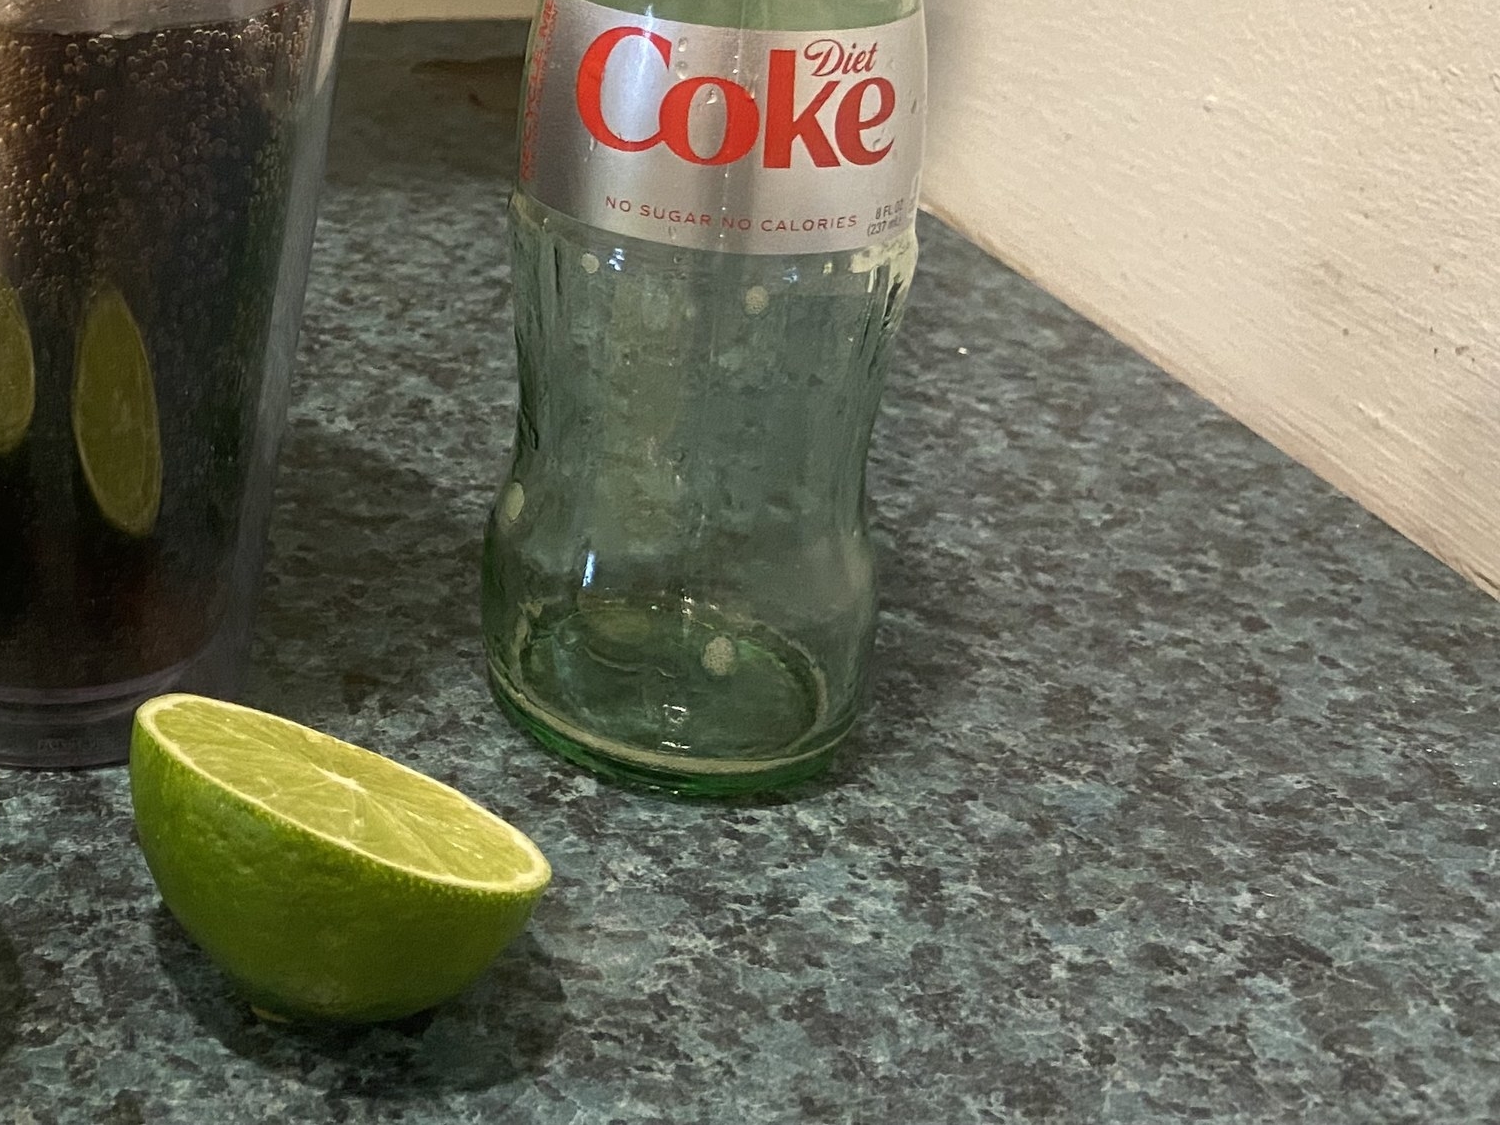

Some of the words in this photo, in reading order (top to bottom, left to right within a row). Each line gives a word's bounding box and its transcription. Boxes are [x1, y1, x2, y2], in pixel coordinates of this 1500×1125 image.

[804, 38, 878, 77] Diet
[575, 26, 896, 169] Coke
[605, 196, 632, 213] NO
[640, 205, 711, 226] SUGAR
[722, 217, 751, 231] NO
[760, 215, 858, 232] CALORIES
